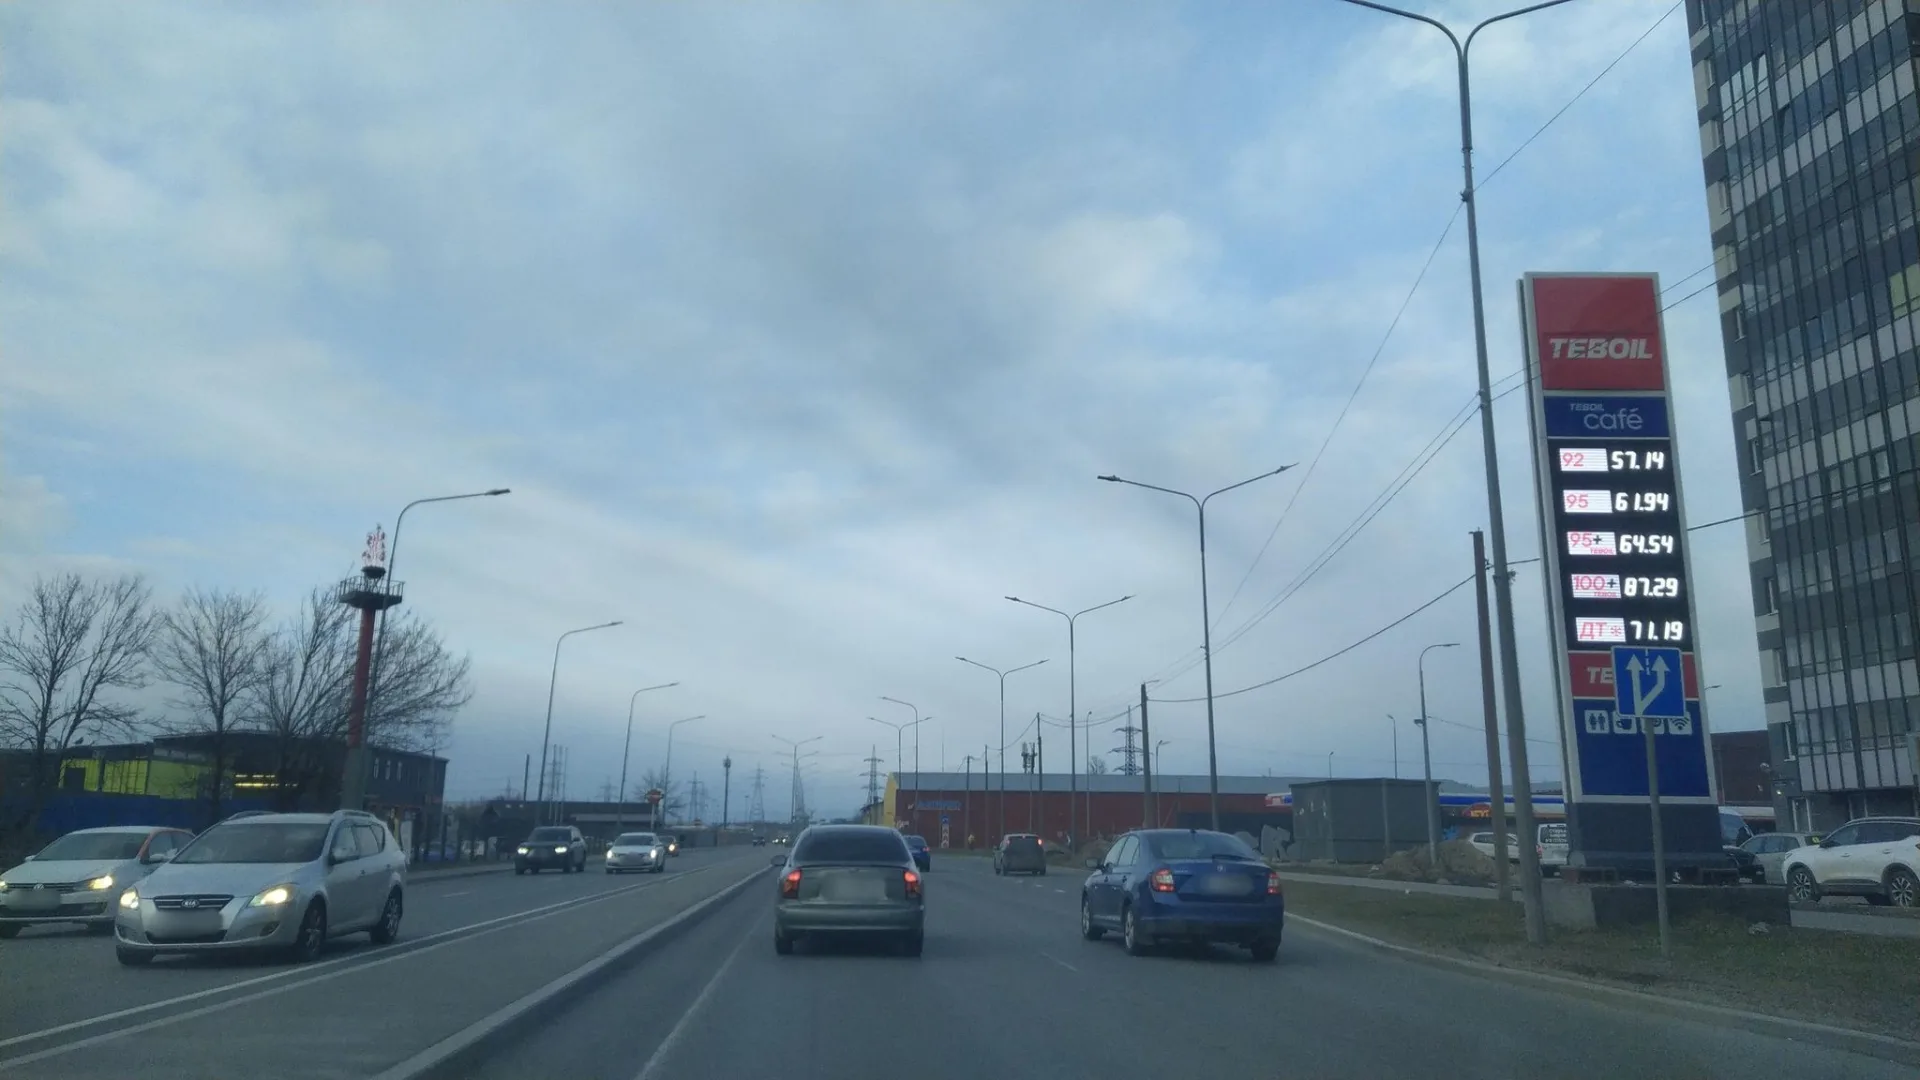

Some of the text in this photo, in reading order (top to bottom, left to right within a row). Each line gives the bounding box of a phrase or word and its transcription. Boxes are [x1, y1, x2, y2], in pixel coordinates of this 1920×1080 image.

[1549, 338, 1653, 360] TEBOIL
[1570, 403, 1605, 412] TEBOIL
[1583, 408, 1643, 430] café
[1562, 450, 1664, 470] 92 57.14
[1566, 492, 1669, 511] 95 61.94
[1570, 532, 1673, 554] 95+ 64.54
[1574, 576, 1678, 597] 100+ 87.29
[1579, 621, 1683, 641] ДТ 71.19
